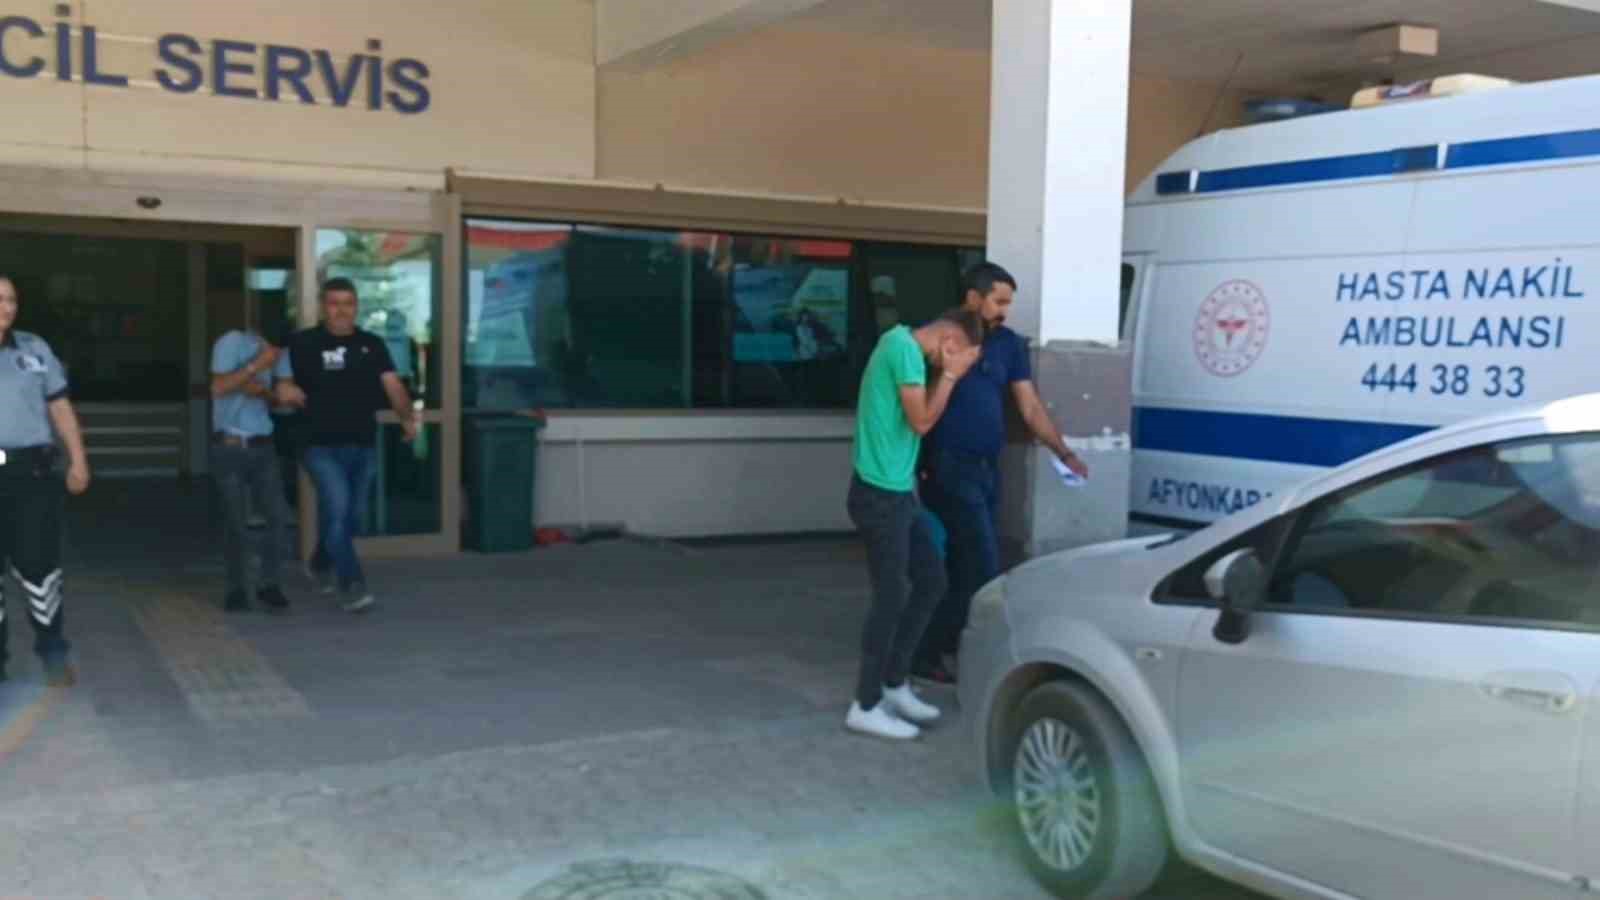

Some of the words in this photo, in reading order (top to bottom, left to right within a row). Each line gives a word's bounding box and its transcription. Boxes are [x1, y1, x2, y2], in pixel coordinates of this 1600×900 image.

[154, 33, 431, 115] SERVİS
[1336, 269, 1450, 301] HASTA
[1463, 257, 1584, 299] NAKİL
[1339, 316, 1565, 349] AMBULANSI
[1361, 362, 1417, 393] 444
[1430, 363, 1470, 396] 38
[1483, 365, 1525, 398] 33
[1150, 477, 1273, 515] AFYONKAR
